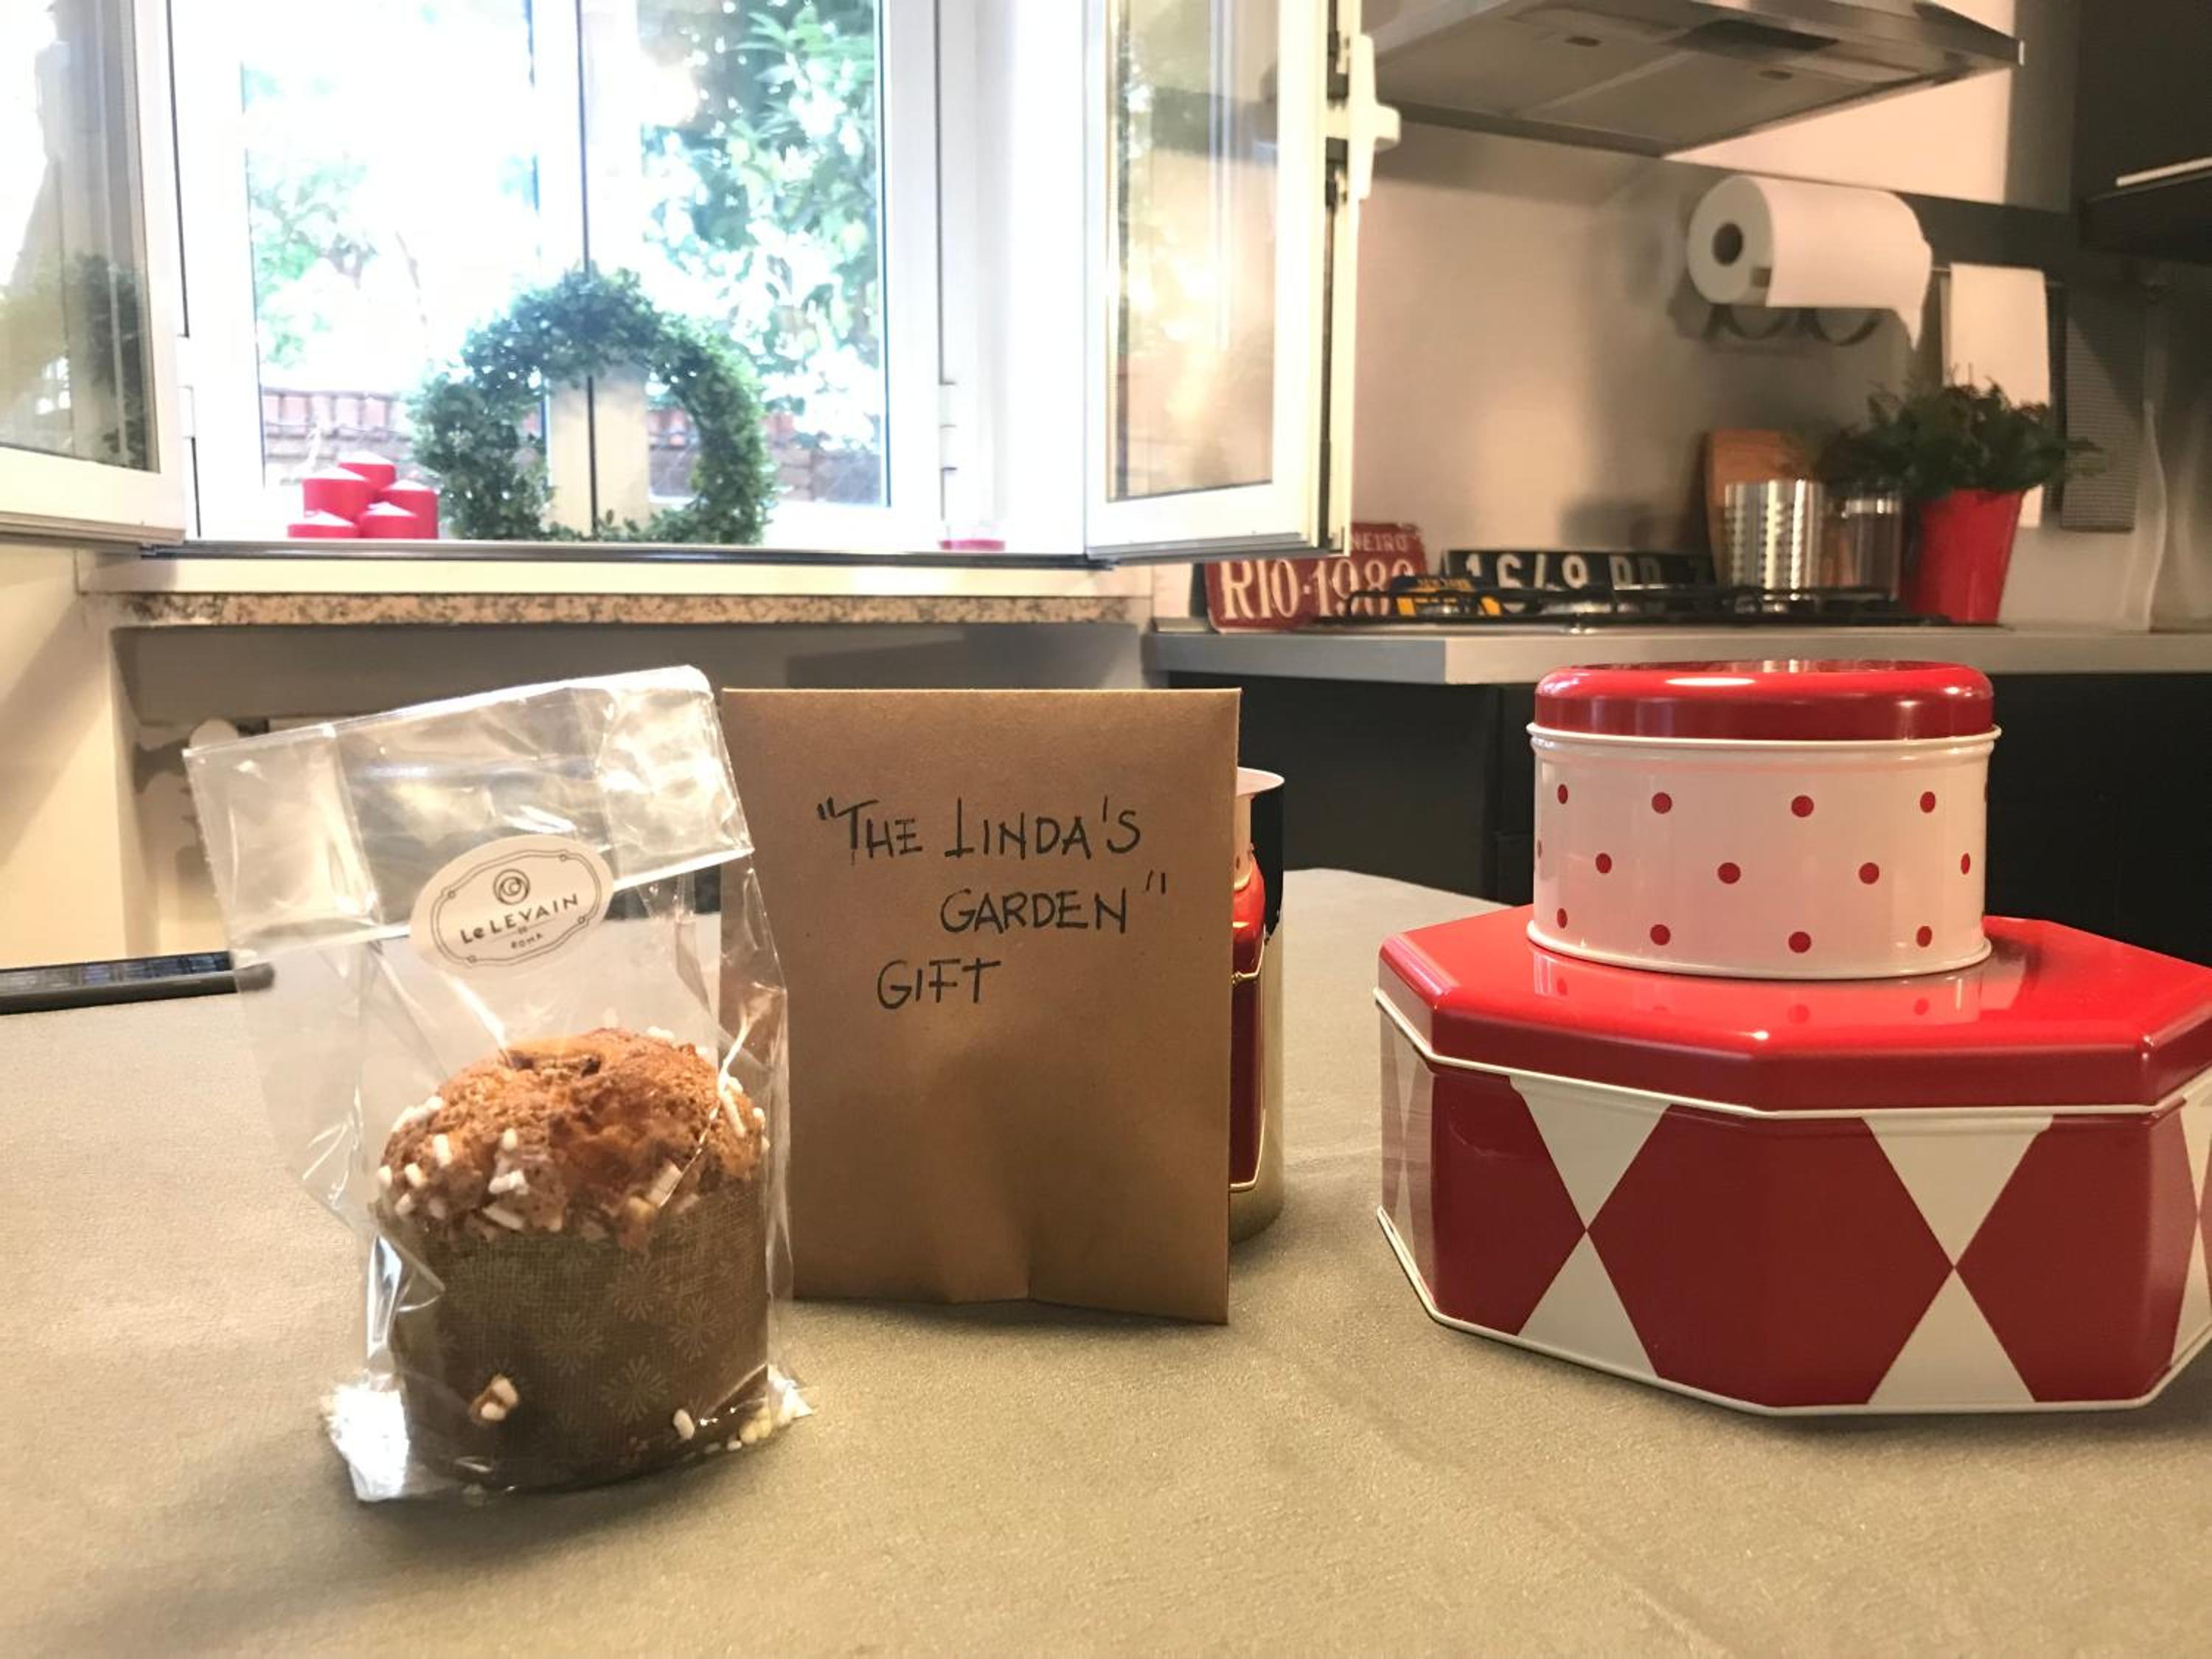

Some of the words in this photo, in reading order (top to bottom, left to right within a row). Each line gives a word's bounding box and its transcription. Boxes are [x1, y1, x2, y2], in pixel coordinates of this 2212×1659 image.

[1352, 532, 1410, 552] NEIRO
[945, 796, 1141, 860] LINDA'S
[877, 959, 1001, 1009] GIFT
